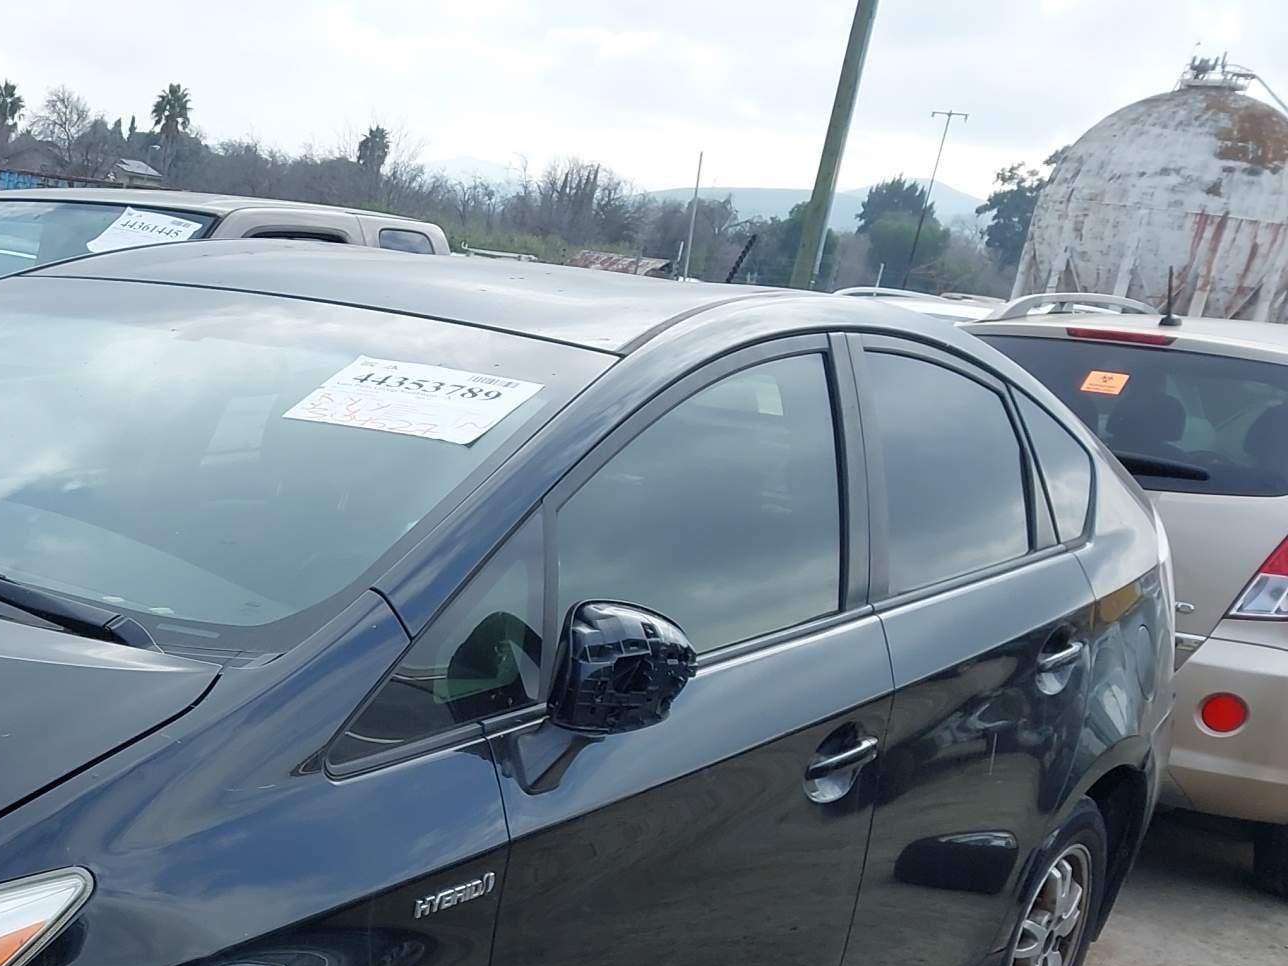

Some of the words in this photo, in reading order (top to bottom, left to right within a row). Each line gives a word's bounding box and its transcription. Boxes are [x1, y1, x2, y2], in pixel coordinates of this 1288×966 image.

[120, 219, 183, 238] 44361445
[352, 372, 504, 401] 44353789
[414, 873, 494, 919] HYBRID
